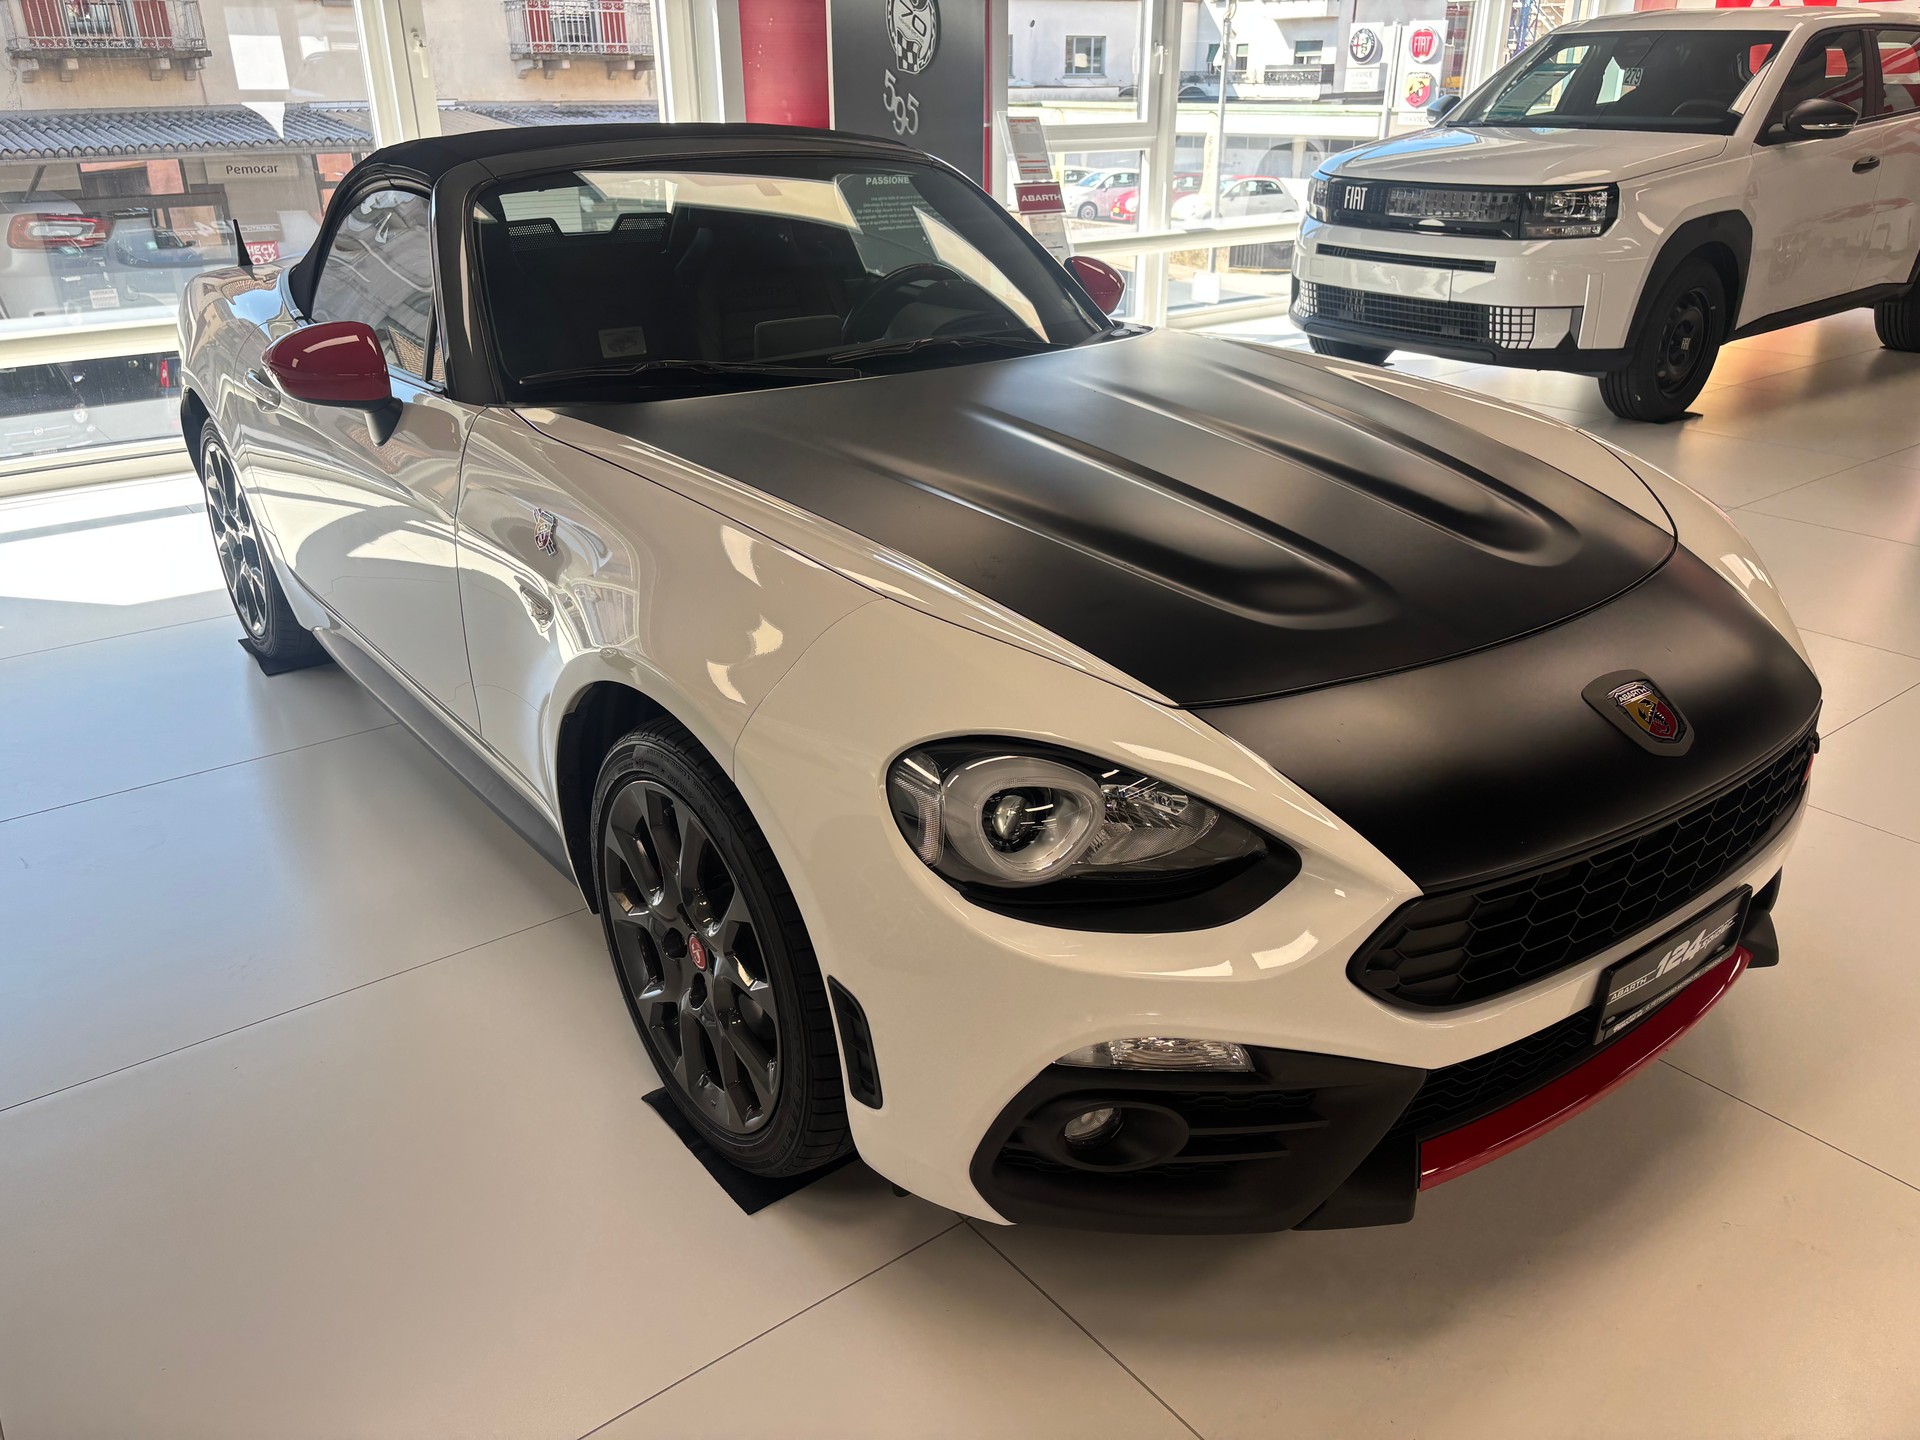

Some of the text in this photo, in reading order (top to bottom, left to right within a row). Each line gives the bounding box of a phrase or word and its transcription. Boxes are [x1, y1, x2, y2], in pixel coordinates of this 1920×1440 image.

[1413, 36, 1432, 55] FIAT
[1624, 68, 1642, 85] 279
[883, 69, 919, 135] 595
[226, 165, 278, 174] Pemocar
[866, 176, 910, 185] PASSIONE
[1021, 194, 1061, 203] ABARTH
[1343, 186, 1368, 210] FIAT
[247, 244, 275, 255] HECK
[1618, 687, 1647, 702] ABARTH
[1610, 977, 1648, 1001] ABARTH
[1655, 929, 1706, 979] 124
